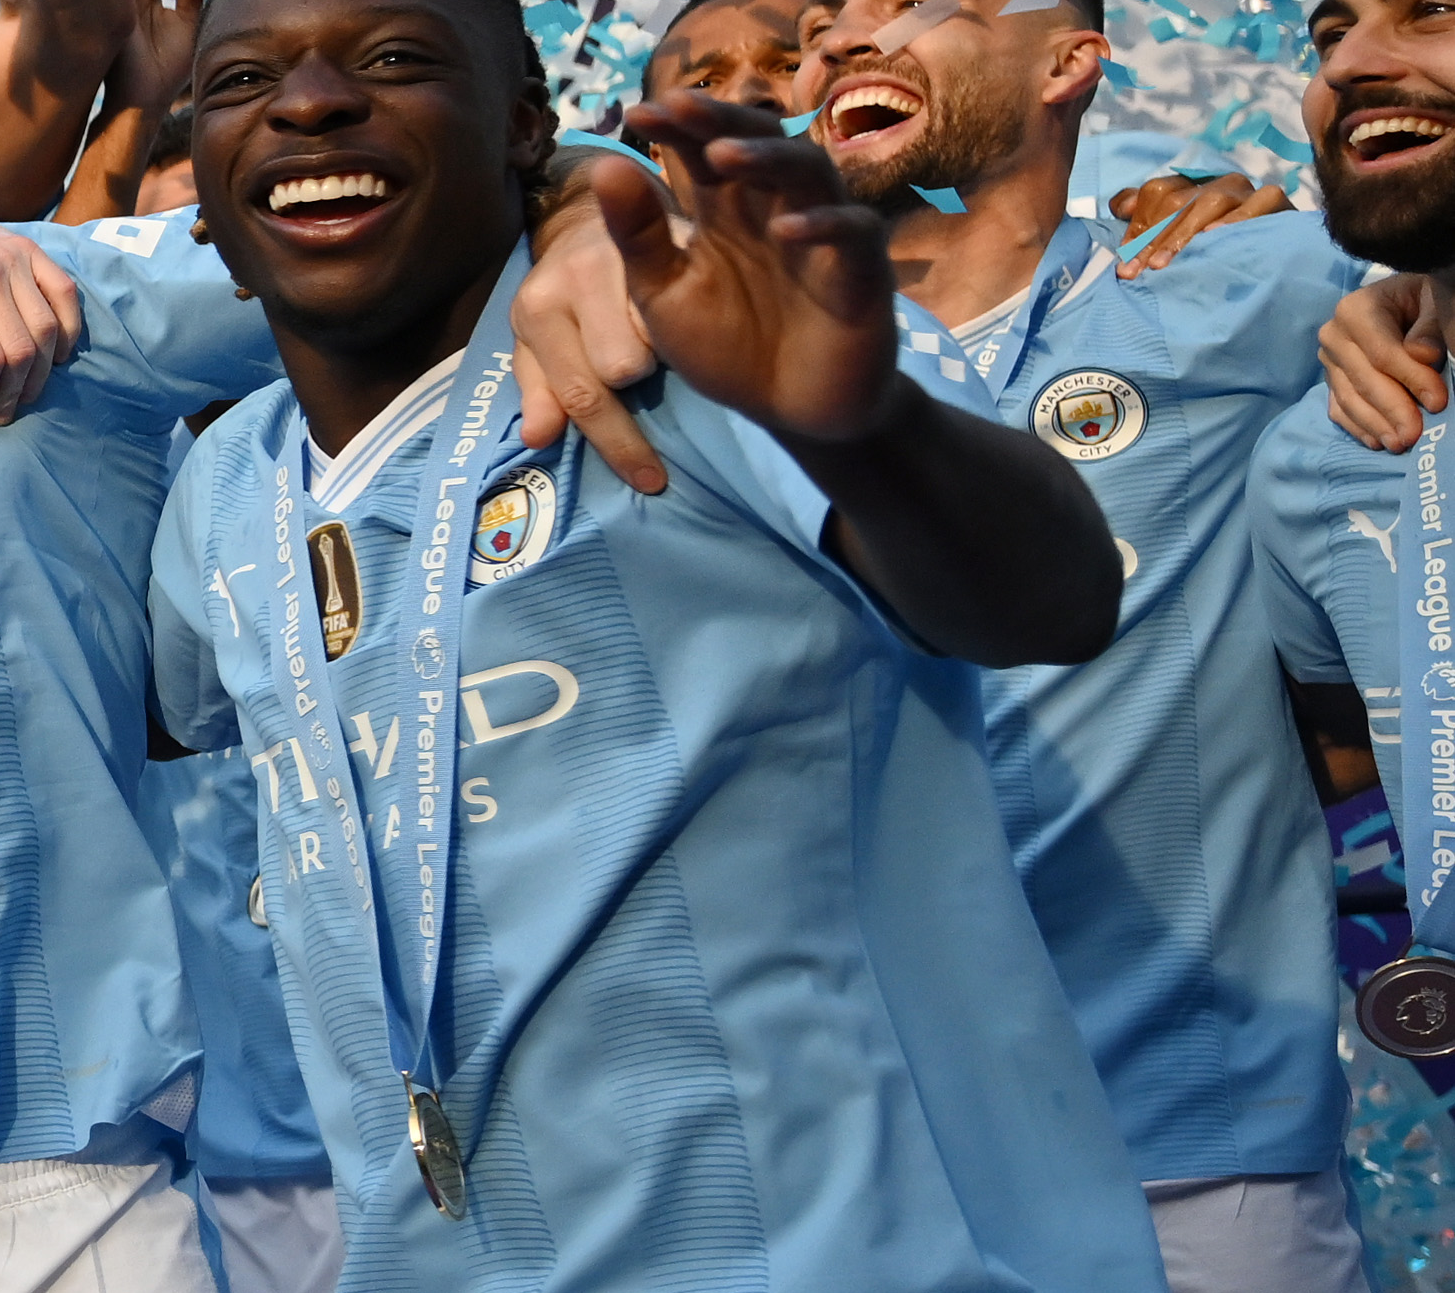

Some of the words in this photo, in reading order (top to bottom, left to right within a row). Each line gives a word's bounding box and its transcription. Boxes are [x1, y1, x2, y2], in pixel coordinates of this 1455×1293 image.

[447, 350, 515, 469] Premier
[1040, 374, 1132, 416] MANCHESTER
[1079, 443, 1112, 459] CITY
[274, 465, 296, 589] League
[1415, 423, 1447, 532] Premier
[420, 477, 473, 618] League
[493, 559, 526, 582] CITY
[1416, 537, 1452, 653] League
[280, 591, 318, 718] Premier
[322, 612, 349, 633] FIFA
[417, 689, 444, 832] Premier
